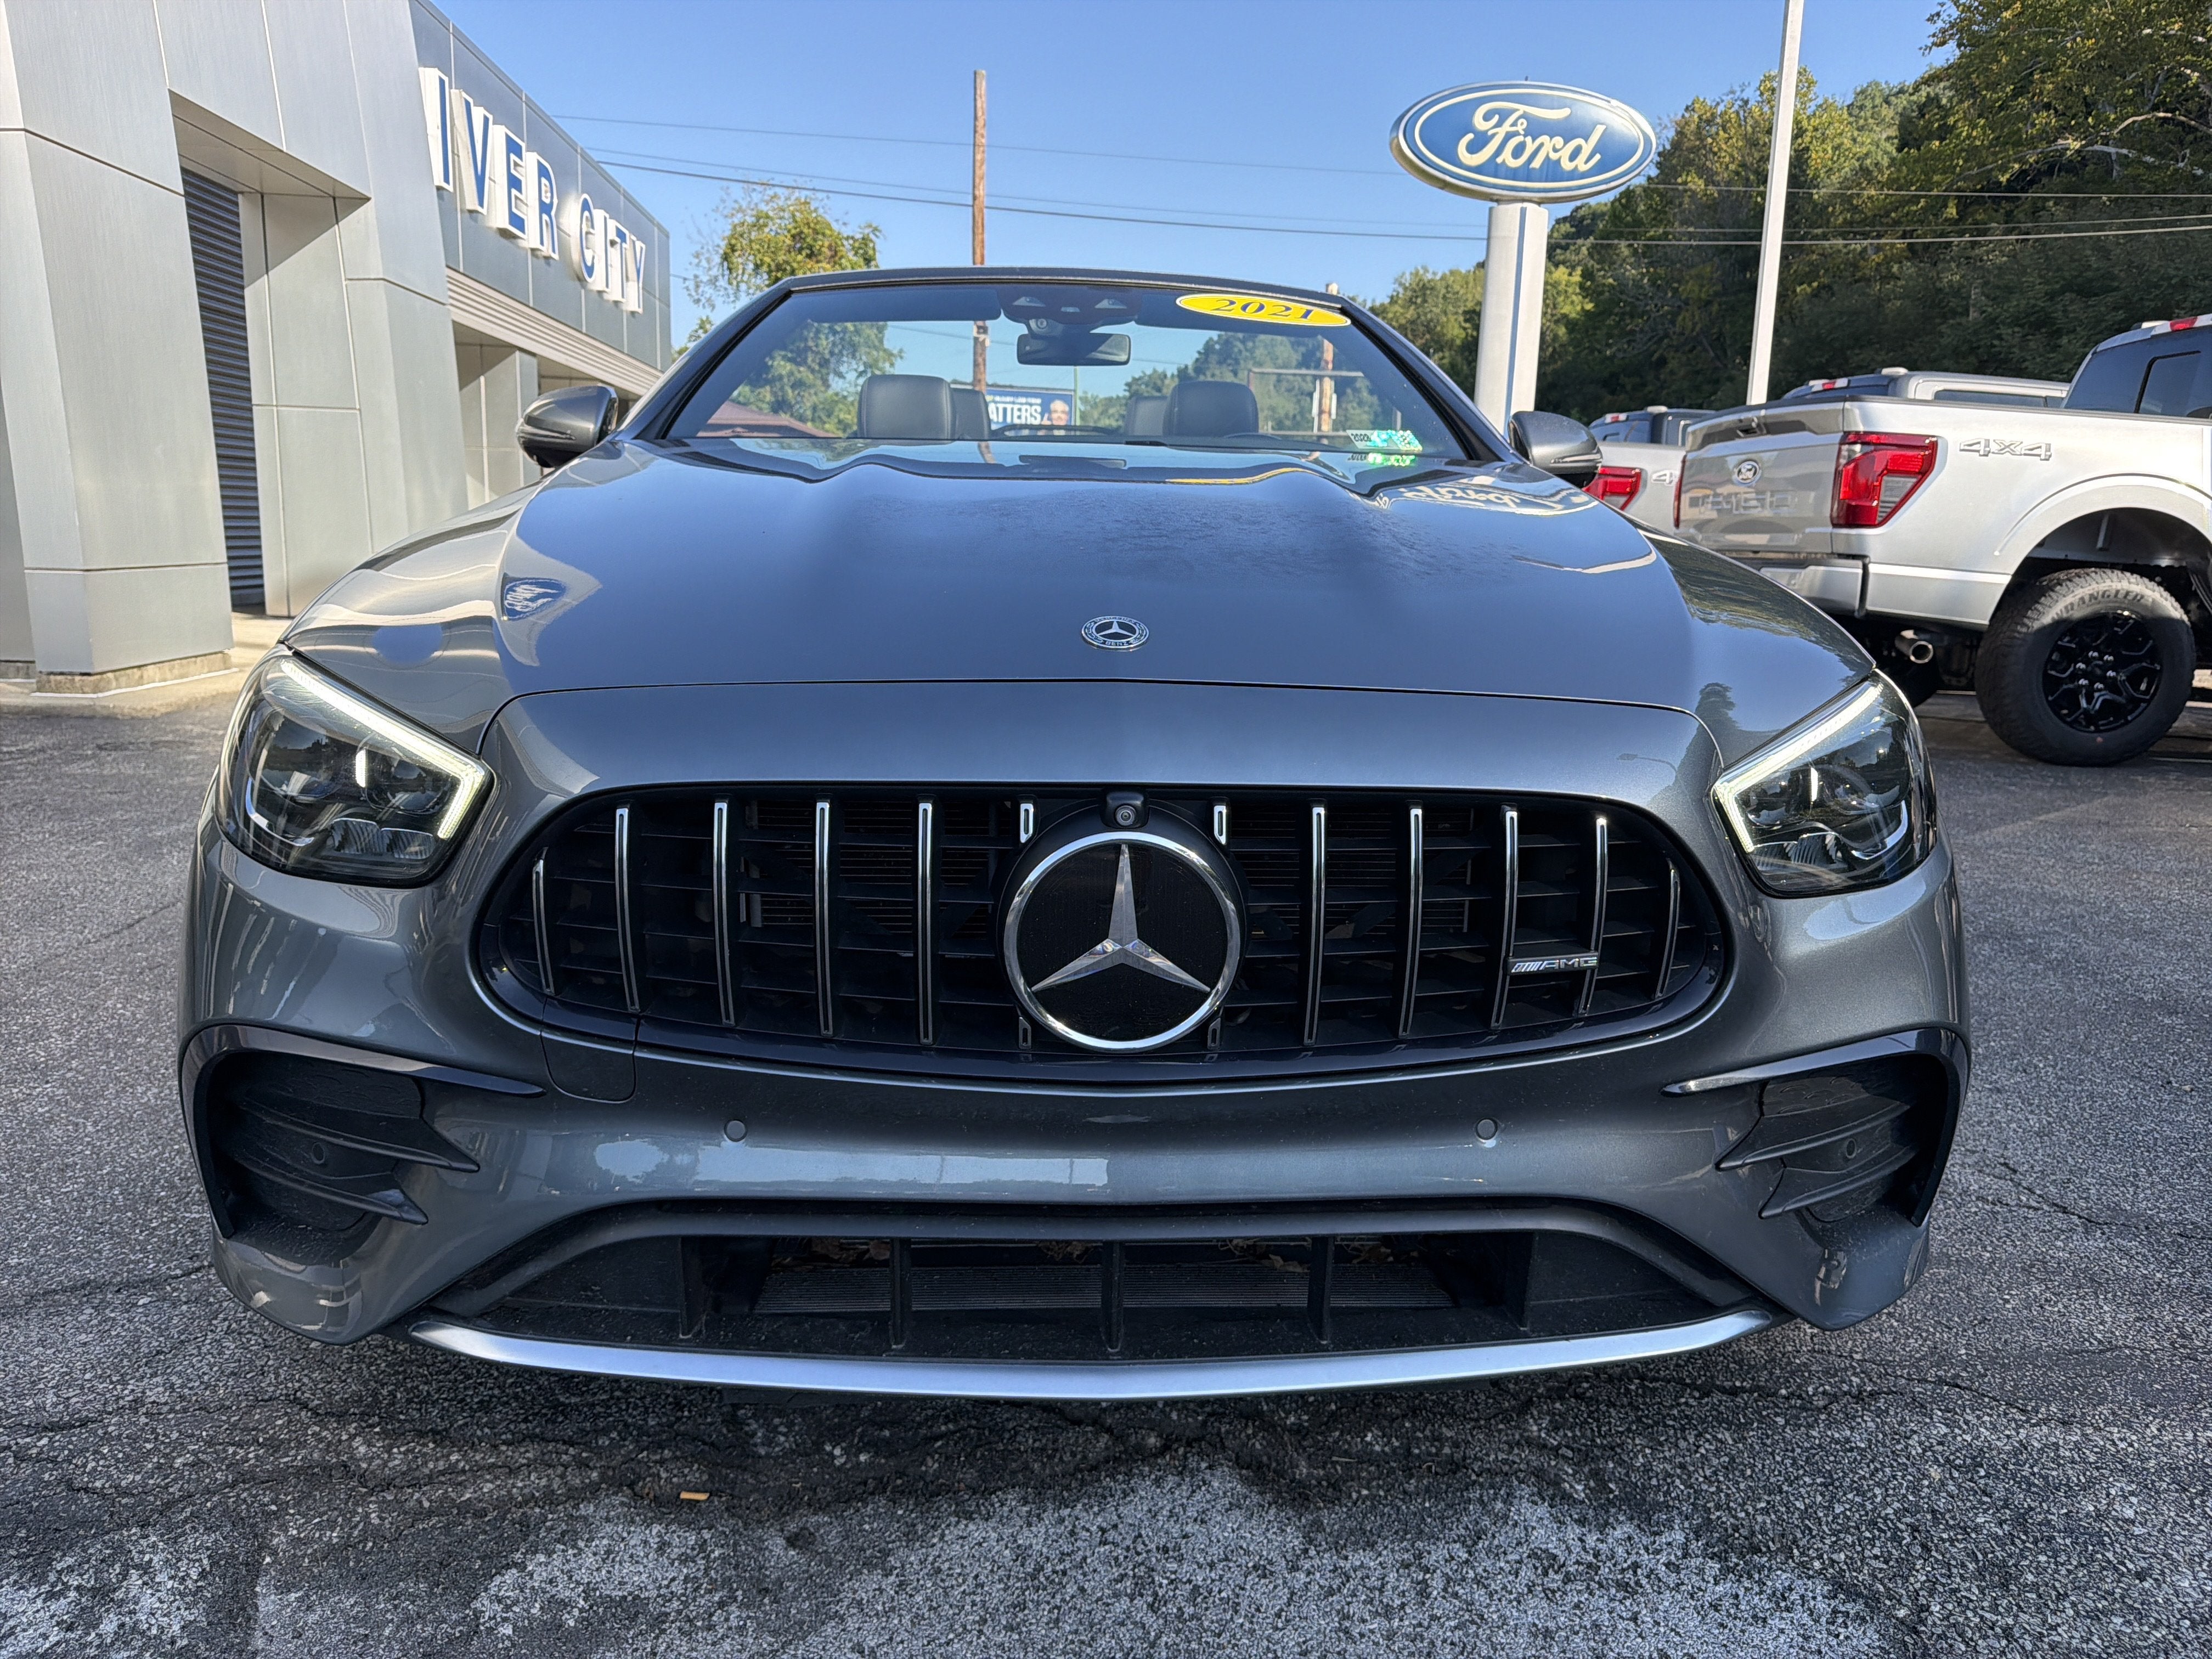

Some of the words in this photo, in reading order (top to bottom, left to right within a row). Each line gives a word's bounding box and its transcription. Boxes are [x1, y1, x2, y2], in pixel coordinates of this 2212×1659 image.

[1457, 101, 1607, 172] Ford
[571, 193, 646, 314] CITY
[1210, 298, 1314, 320] 2021
